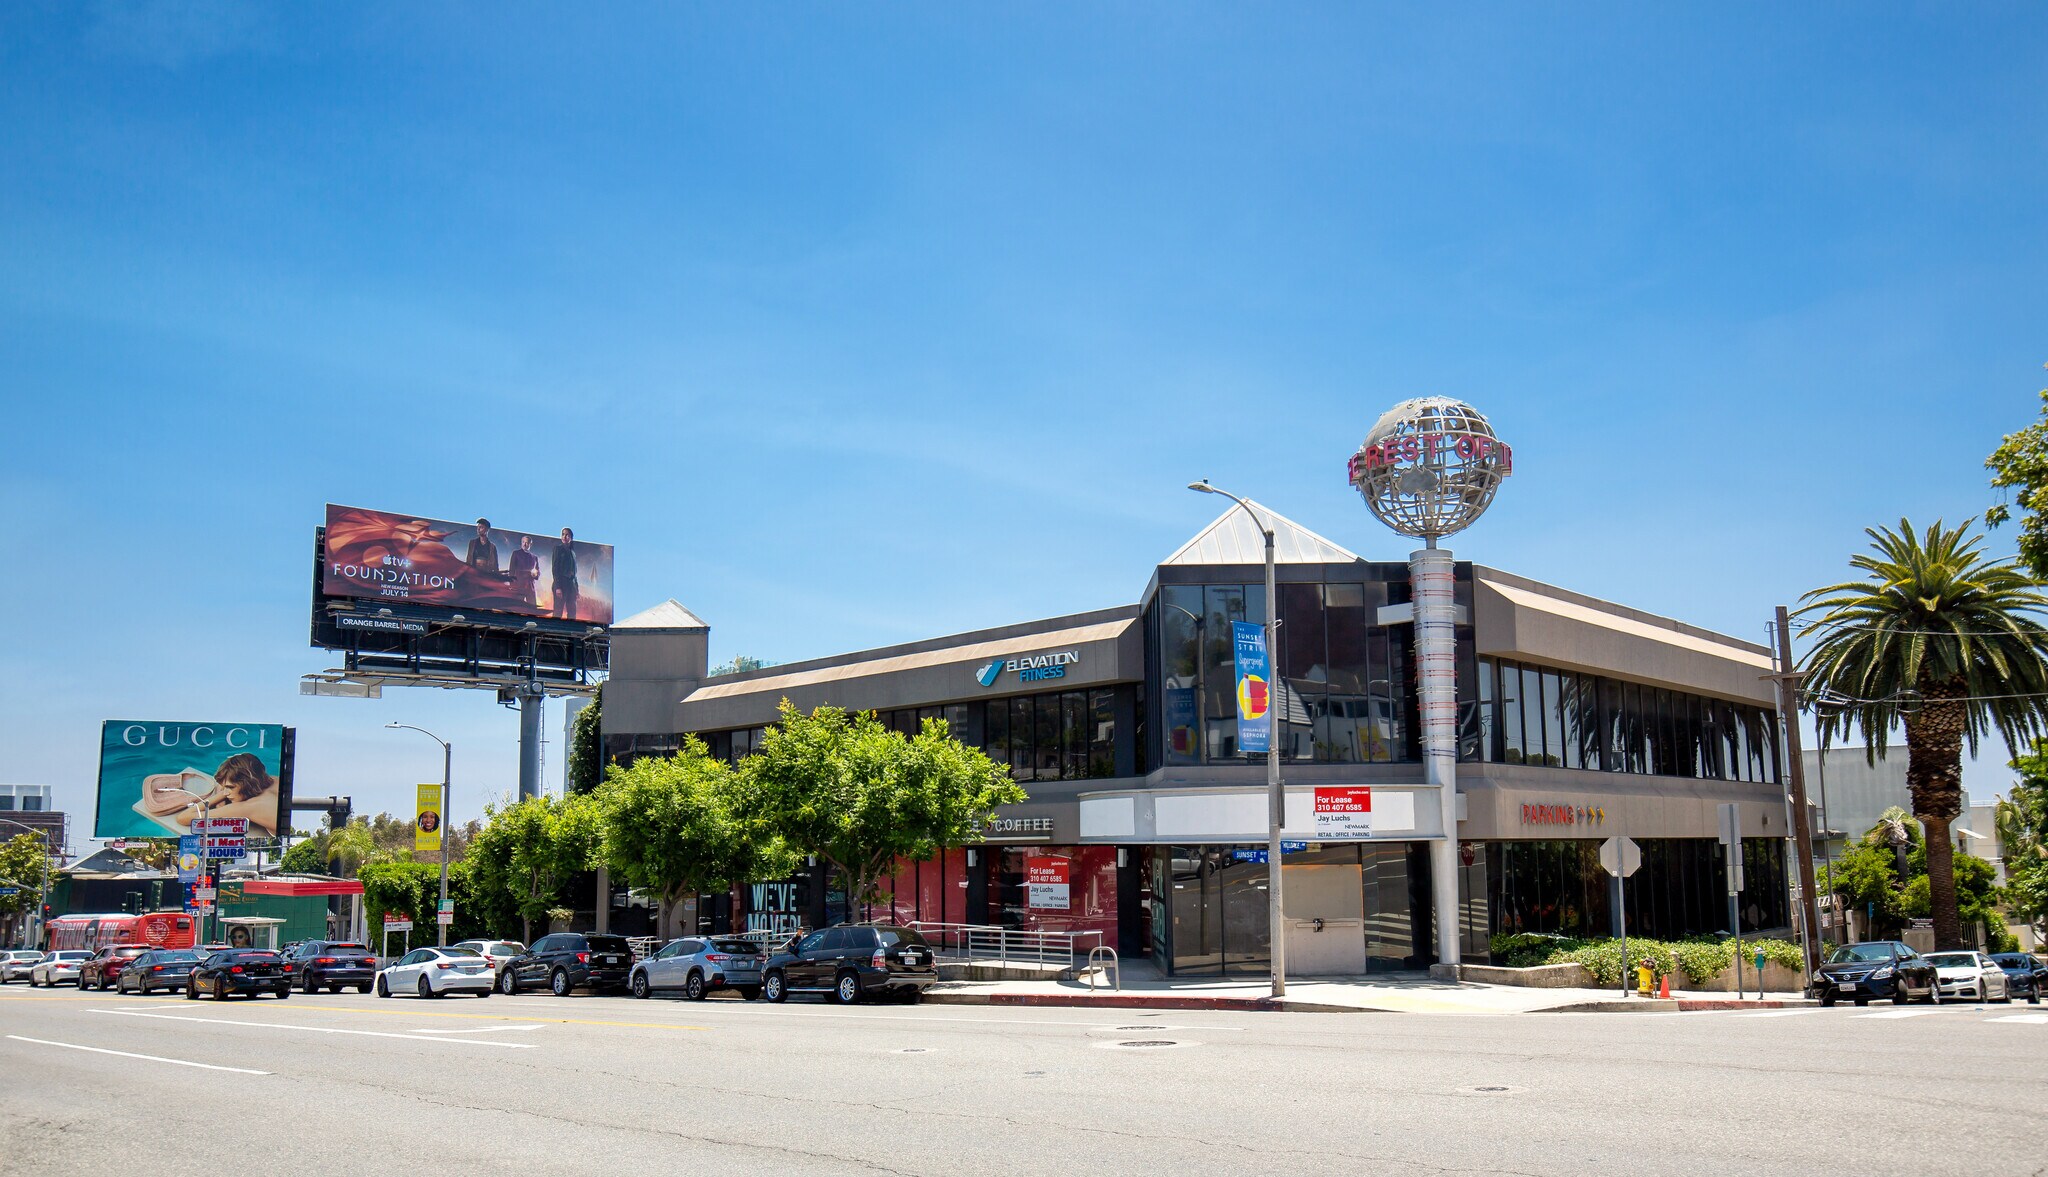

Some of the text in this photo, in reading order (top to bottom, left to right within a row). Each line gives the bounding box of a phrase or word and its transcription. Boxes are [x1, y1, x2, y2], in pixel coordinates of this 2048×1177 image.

[1365, 434, 1442, 470] REST
[1455, 435, 1493, 460] OF
[334, 563, 455, 589] FOUNDATION
[381, 589, 399, 597] JULY
[343, 618, 425, 631] ORANGE BARREL MEDIA
[1006, 650, 1079, 673] ELEVATION
[1020, 665, 1066, 682] FITNESS
[122, 724, 265, 749] GUCCI
[212, 819, 245, 827] SUNSET
[1523, 804, 1575, 824] PARKING
[995, 818, 1052, 832] COFFEE
[208, 848, 244, 857] HOURS
[752, 884, 797, 911] WE'VE
